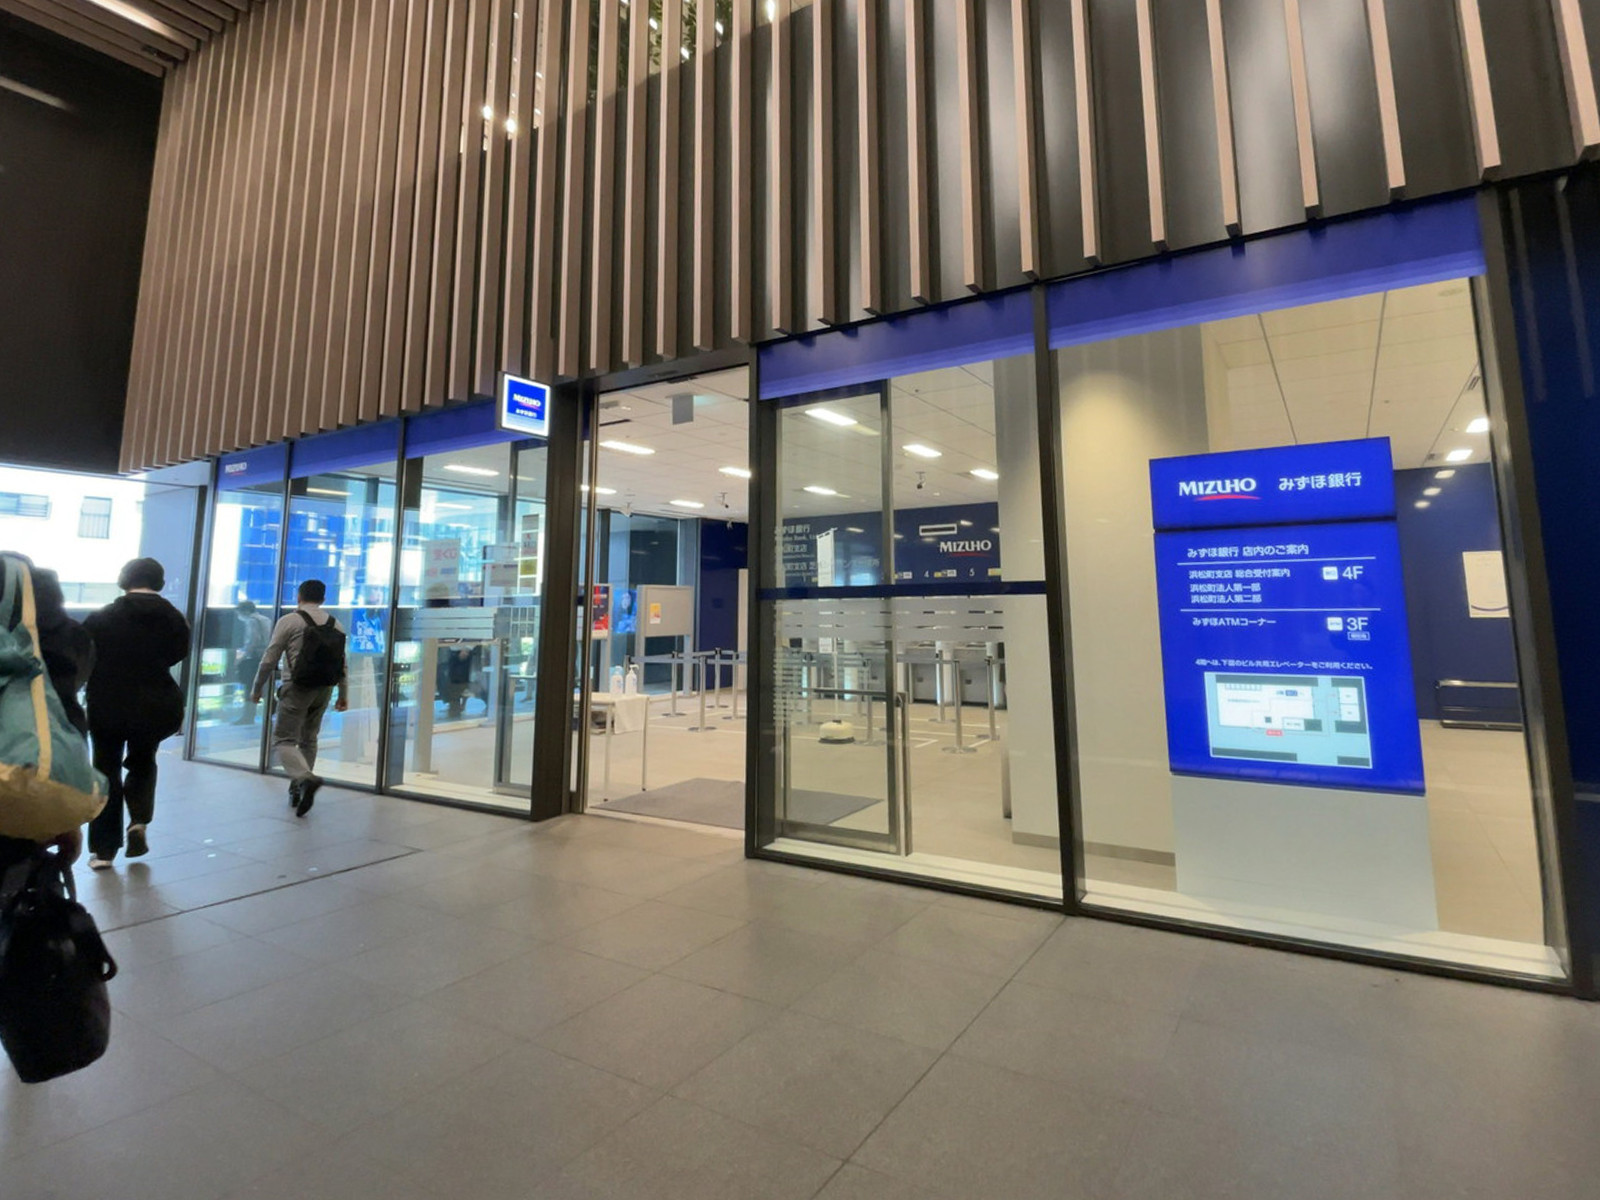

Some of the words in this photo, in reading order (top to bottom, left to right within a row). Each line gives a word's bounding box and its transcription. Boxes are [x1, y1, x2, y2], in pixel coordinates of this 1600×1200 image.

[1179, 477, 1257, 497] MIZUHO
[1278, 472, 1363, 491] みずほ銀行
[940, 539, 992, 553] MIZUHO
[1187, 546, 1239, 558] みずほ銀行
[1342, 565, 1364, 580] 4F
[1346, 616, 1369, 631] 3F
